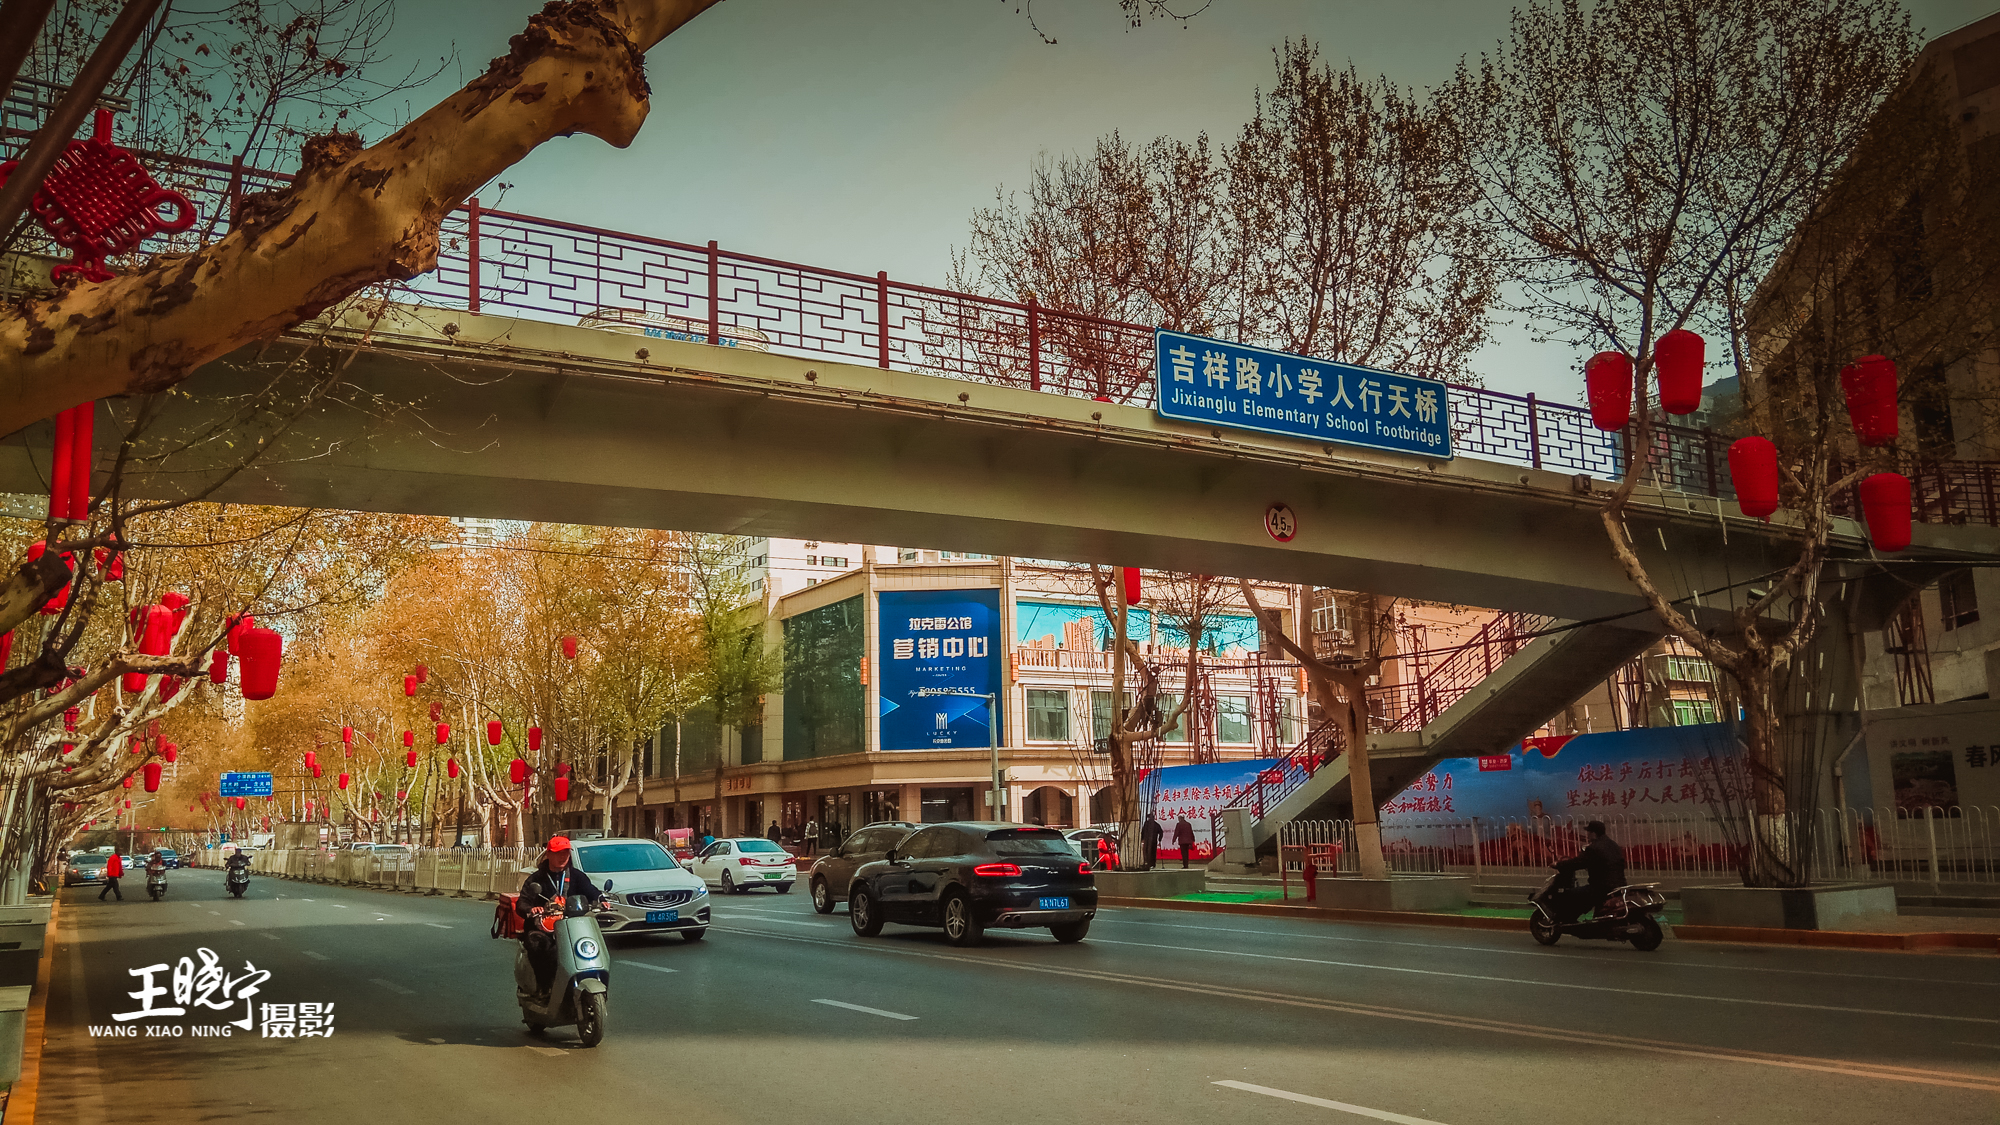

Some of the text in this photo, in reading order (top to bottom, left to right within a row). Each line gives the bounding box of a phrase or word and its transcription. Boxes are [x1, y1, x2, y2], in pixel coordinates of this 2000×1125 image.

[1169, 345, 1439, 424] 吉祥路小学人行天桥
[1171, 388, 1442, 447] Jixianglu Elementary School Footbridge
[908, 616, 973, 631] 拉克雷公馆
[893, 636, 988, 660] 营销中心
[1380, 794, 1456, 815] 会和谐稳定
